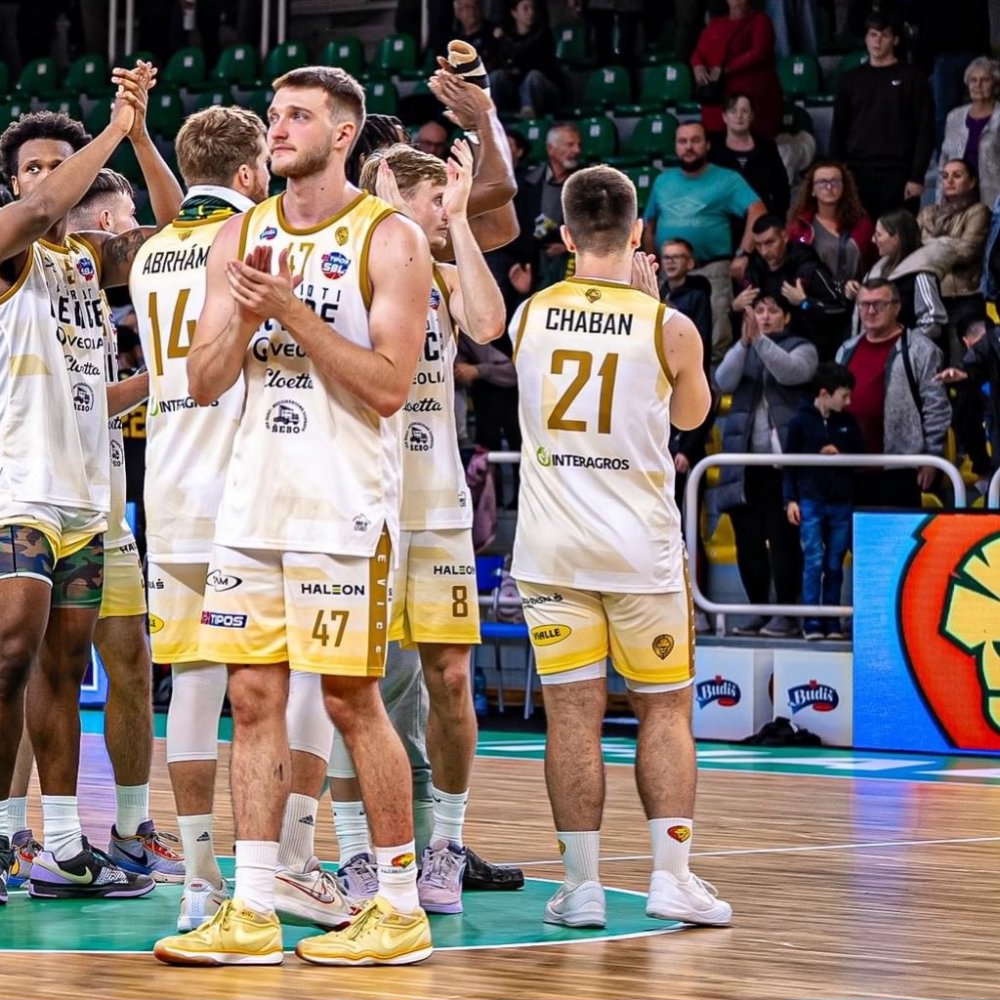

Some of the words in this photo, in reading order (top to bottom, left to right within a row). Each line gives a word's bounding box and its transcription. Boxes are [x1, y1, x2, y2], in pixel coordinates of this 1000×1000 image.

[142, 244, 211, 275] ABRHÁM
[148, 288, 198, 376] 14
[545, 308, 633, 336] CHABAN
[547, 349, 619, 434] 21
[551, 453, 630, 470] INTERAGROS
[301, 582, 366, 597] HALEON
[451, 585, 469, 618] 8
[311, 608, 351, 648] 47
